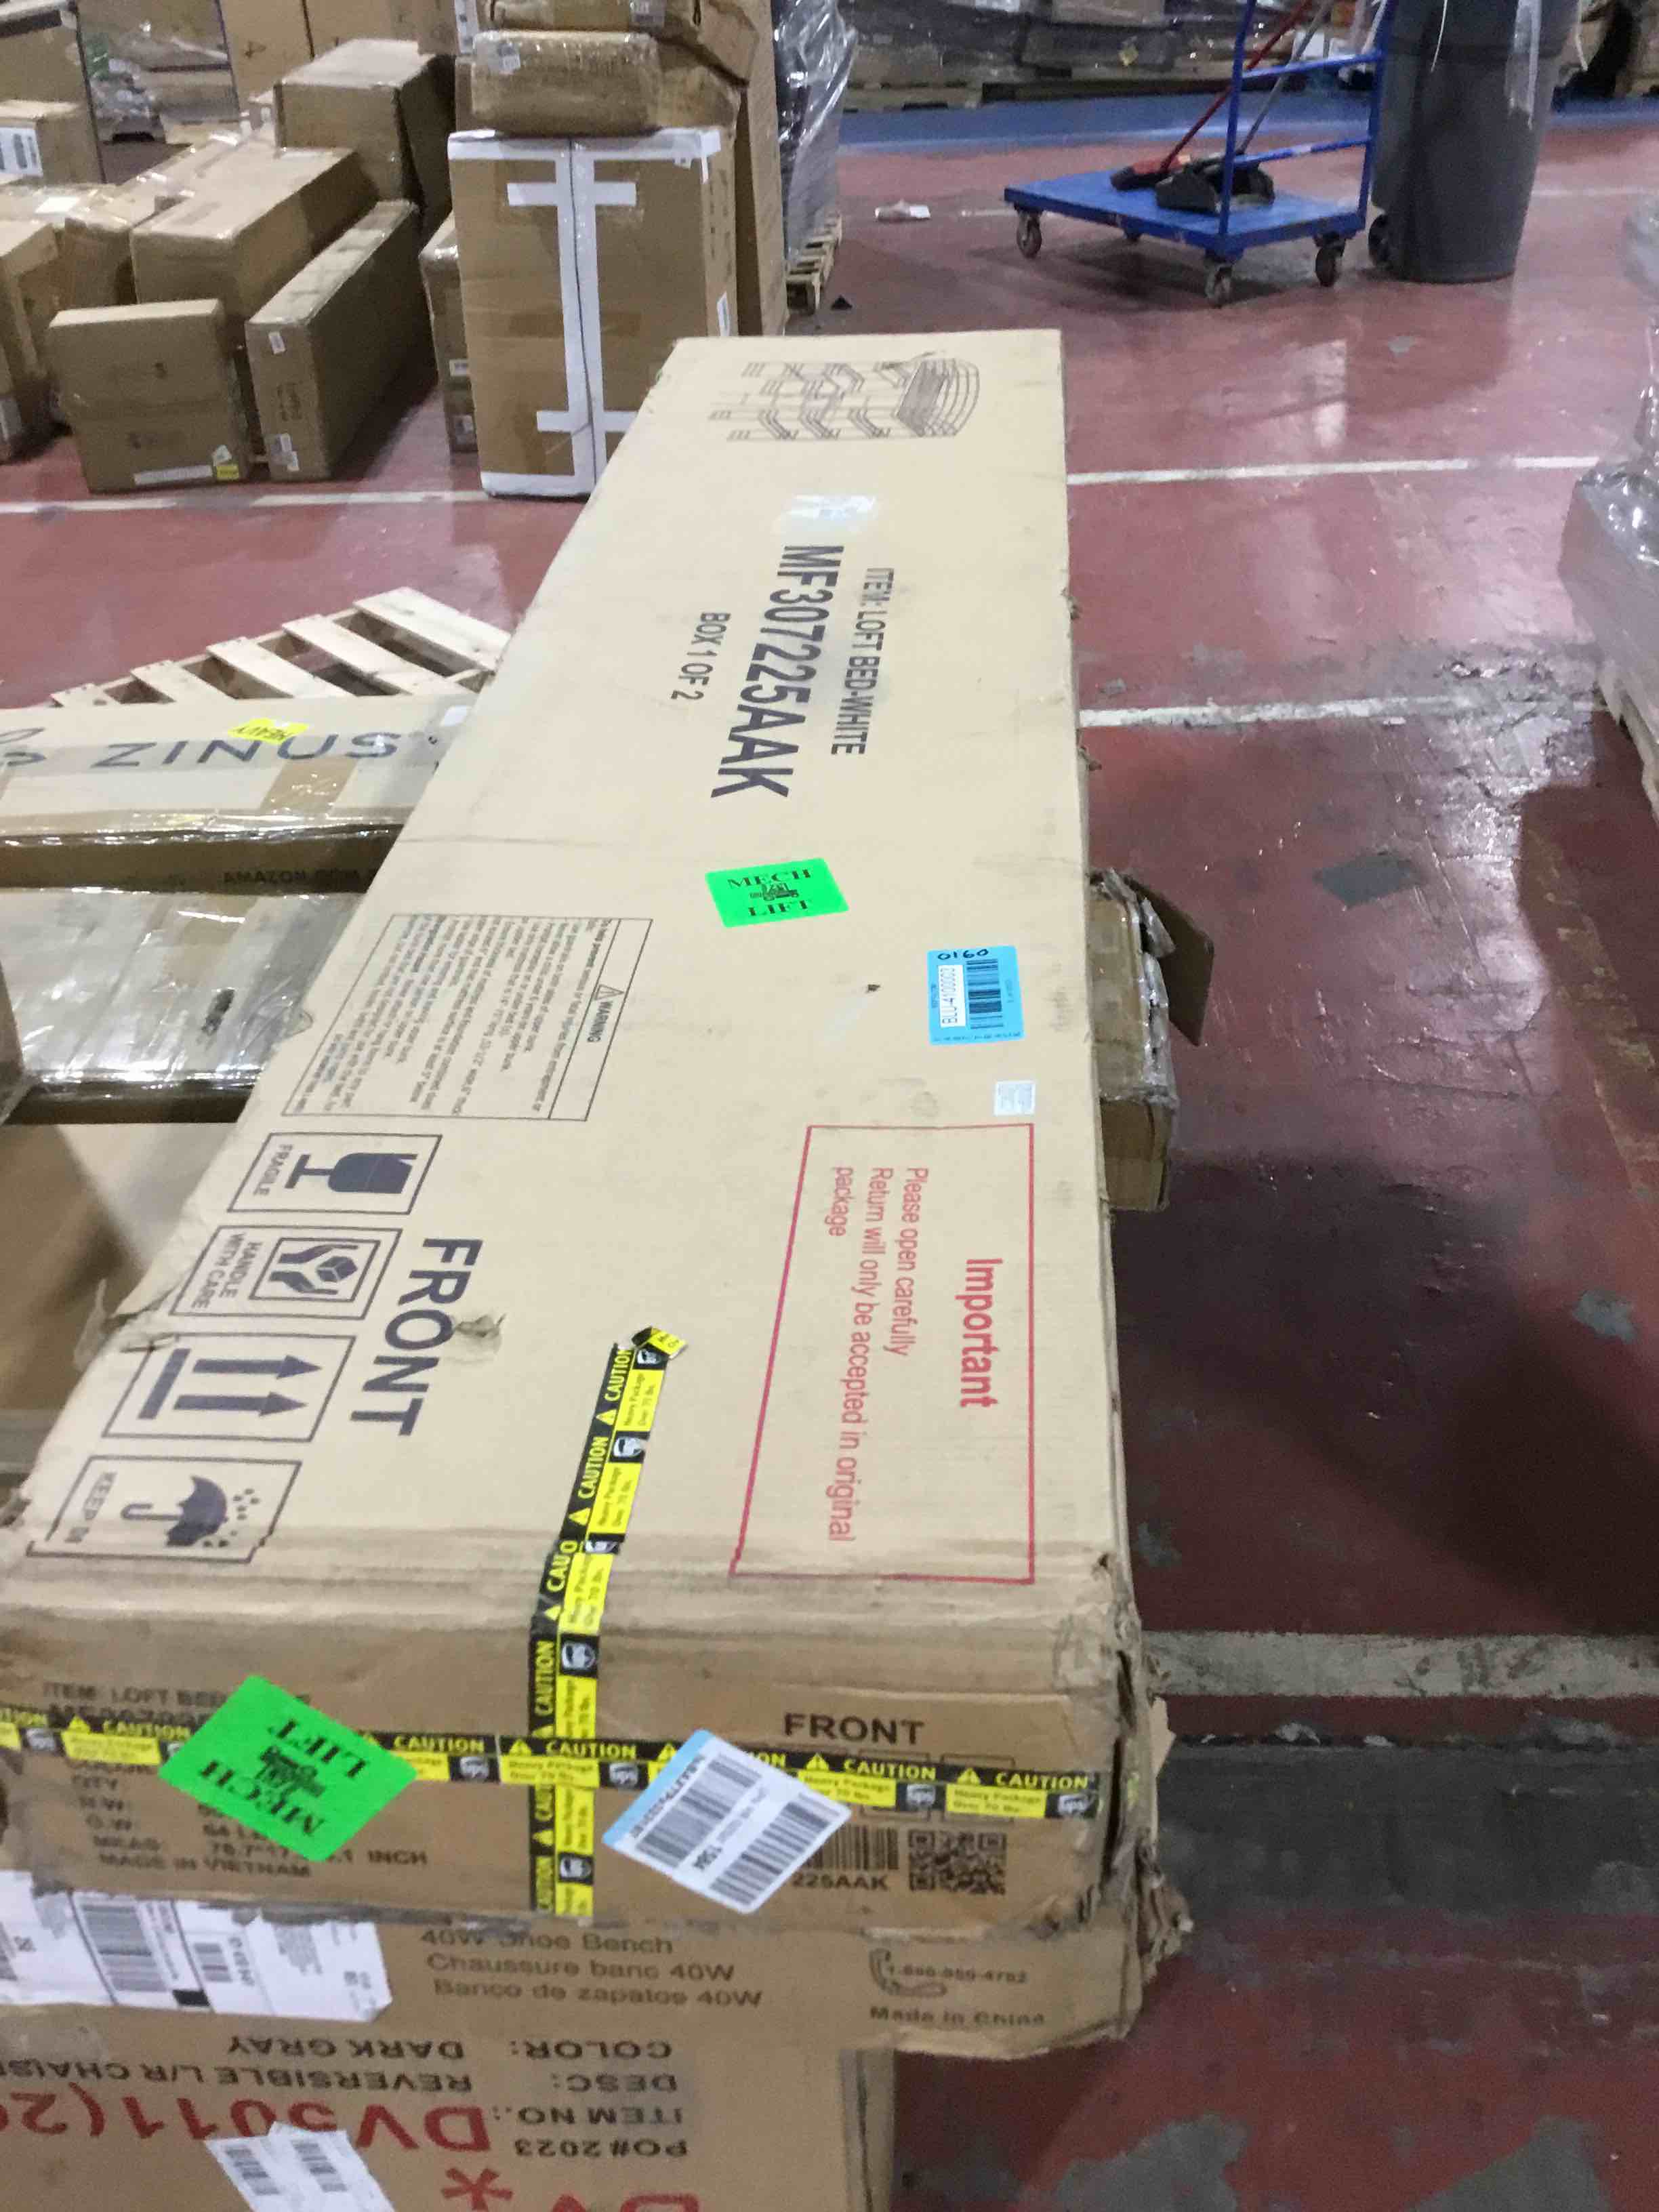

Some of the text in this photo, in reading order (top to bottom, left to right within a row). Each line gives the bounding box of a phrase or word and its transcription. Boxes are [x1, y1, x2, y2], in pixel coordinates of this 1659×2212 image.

[691, 612, 731, 646] BOX
[851, 610, 888, 651] LOFT
[678, 662, 714, 685] OF
[710, 545, 844, 798] MF307225AAK
[671, 689, 705, 700] 2
[830, 656, 880, 755] BED-WHITE
[90, 731, 401, 769] ZINUS
[727, 868, 813, 890] MECH
[748, 899, 813, 916] LIFT
[587, 1000, 613, 1042] WARNING
[253, 1143, 293, 1197] FRAGILE
[823, 1166, 855, 1237] package
[190, 1232, 248, 1310] WITH CARE
[220, 1241, 262, 1298] HANDLE
[882, 1167, 928, 1356] Please open carefully
[349, 1237, 484, 1437] FRONT
[955, 1258, 1002, 1408] Important
[825, 1167, 893, 1543] Return will only be accepted in original
[605, 1348, 633, 1401] CAUTION
[577, 1437, 609, 1499] CAUTION
[83, 1471, 117, 1522] KEEP
[535, 1640, 554, 1716] CAUTION
[102, 1719, 191, 1741] CAUTION
[394, 1734, 485, 1754] CAUTION
[784, 1713, 925, 1745] FRONT
[268, 1718, 367, 1779] LIFT
[546, 1740, 637, 1759] CAUTION
[844, 1759, 937, 1780] CAUTION
[996, 1772, 1088, 1789] CAUTION
[199, 1760, 325, 1835] MECH
[205, 1858, 311, 1878] VIETNAM
[368, 1849, 429, 1866] INCH
[420, 1928, 485, 1946] 40W
[583, 1933, 674, 1954] Bench
[426, 1952, 735, 1982] Chaussure banc 40W
[433, 1978, 764, 2008] Banco de zapatos 40W
[870, 2006, 1046, 2027] Made in China
[228, 2035, 673, 2060] COLOR: DARK GRAY
[139, 2063, 205, 2083] L/R
[214, 2067, 472, 2093] REVERSIBLE
[551, 2072, 678, 2093] DESC:
[588, 2105, 684, 2125] ITEM
